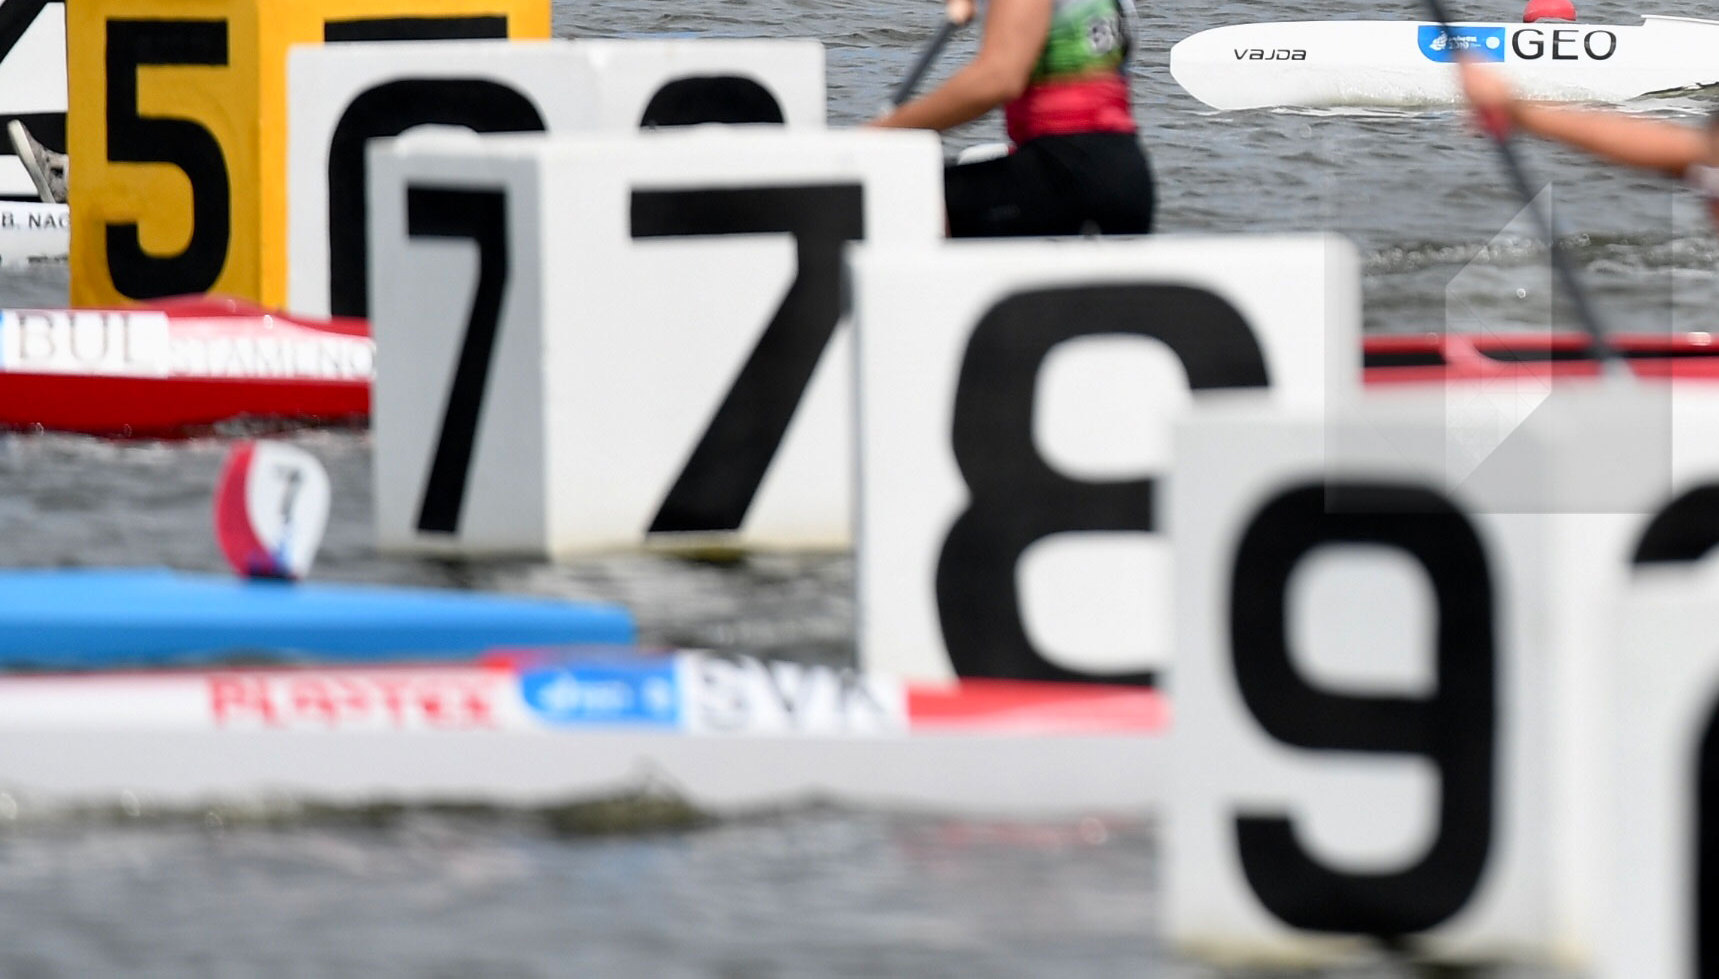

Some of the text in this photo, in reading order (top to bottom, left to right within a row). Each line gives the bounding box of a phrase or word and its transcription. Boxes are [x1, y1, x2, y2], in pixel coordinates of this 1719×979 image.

[105, 18, 231, 300] 5
[1511, 28, 1617, 61] GEO
[18, 310, 148, 366] BUL
[405, 185, 508, 534] 7
[629, 183, 864, 533] 7
[936, 281, 1272, 687] 8
[1226, 477, 1500, 934] 9
